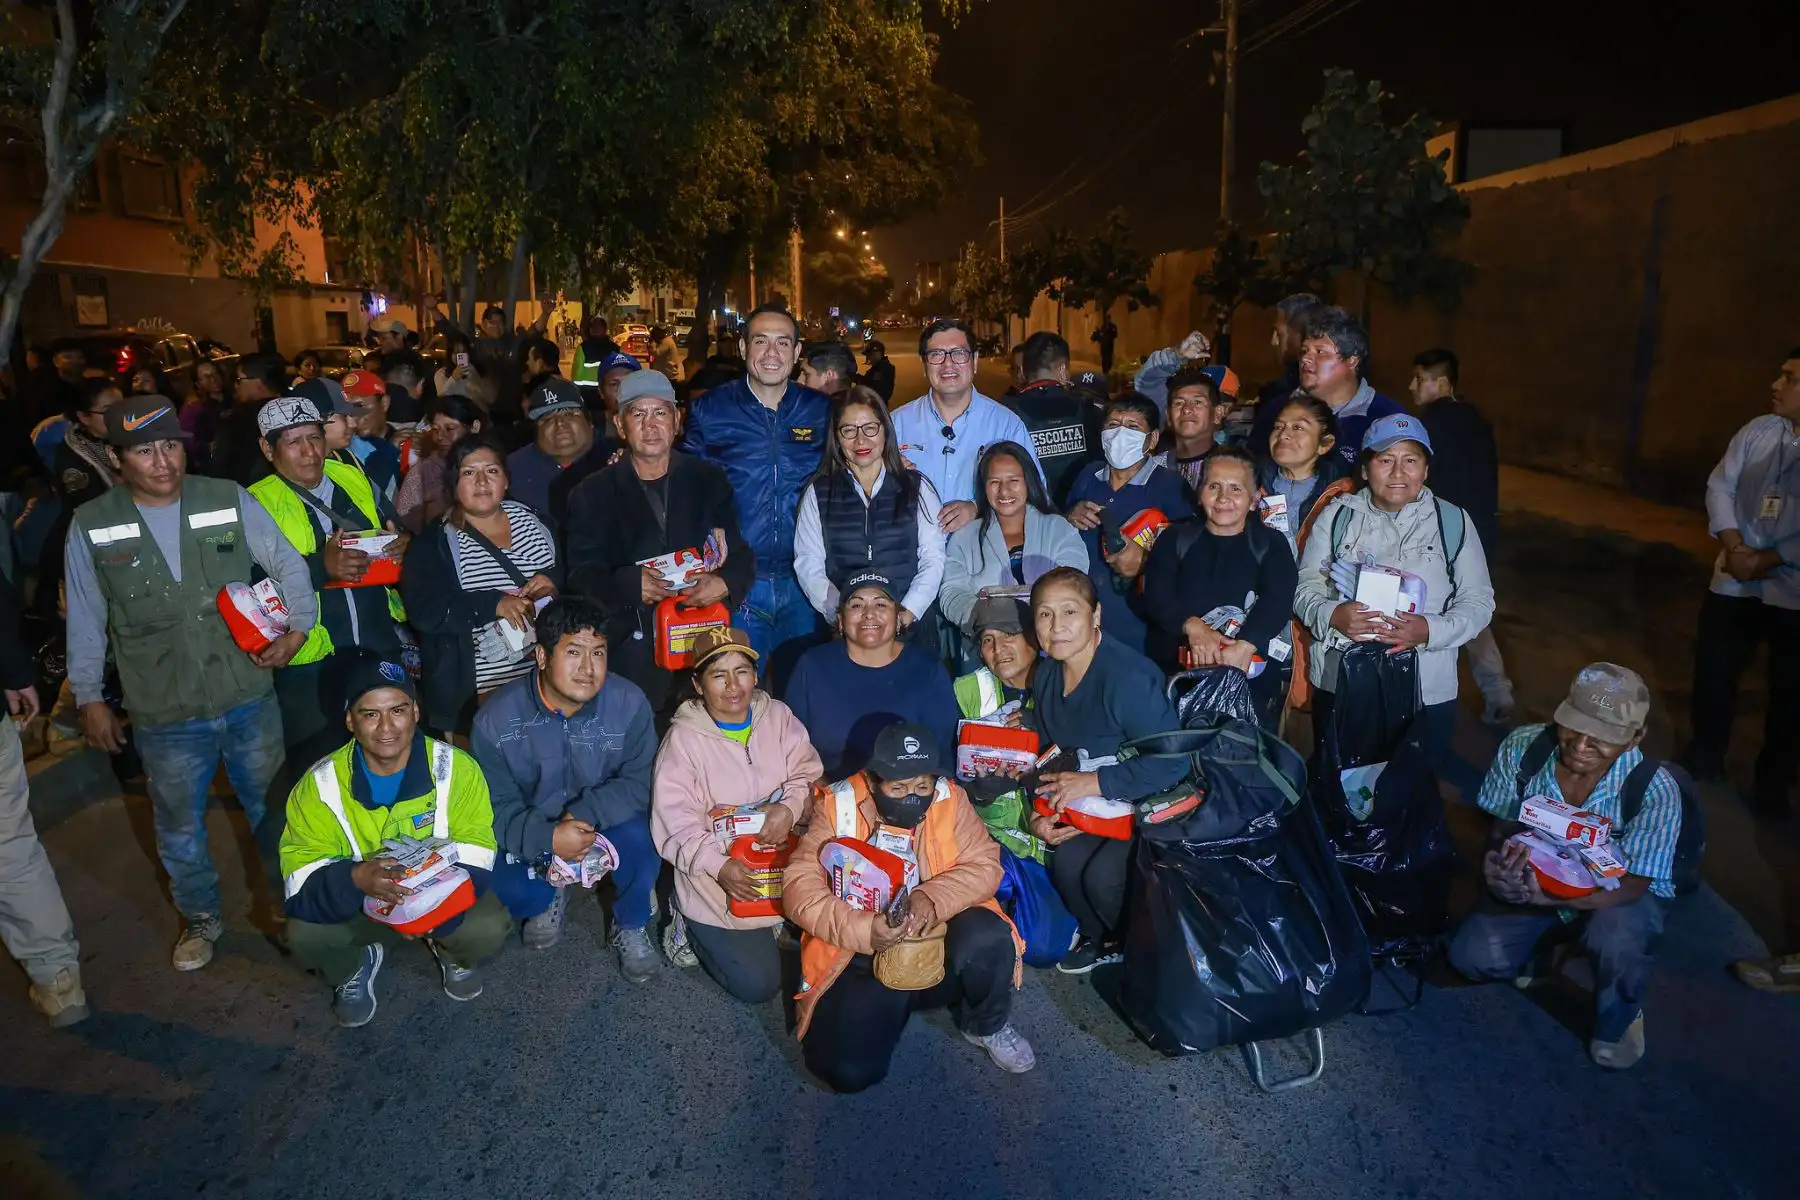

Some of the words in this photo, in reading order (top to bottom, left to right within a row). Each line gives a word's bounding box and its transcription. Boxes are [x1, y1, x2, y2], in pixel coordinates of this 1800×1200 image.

[543, 388, 558, 404] LA
[1031, 427, 1082, 446] ESCOLTA
[850, 573, 889, 585] adidas
[709, 626, 733, 646] NY
